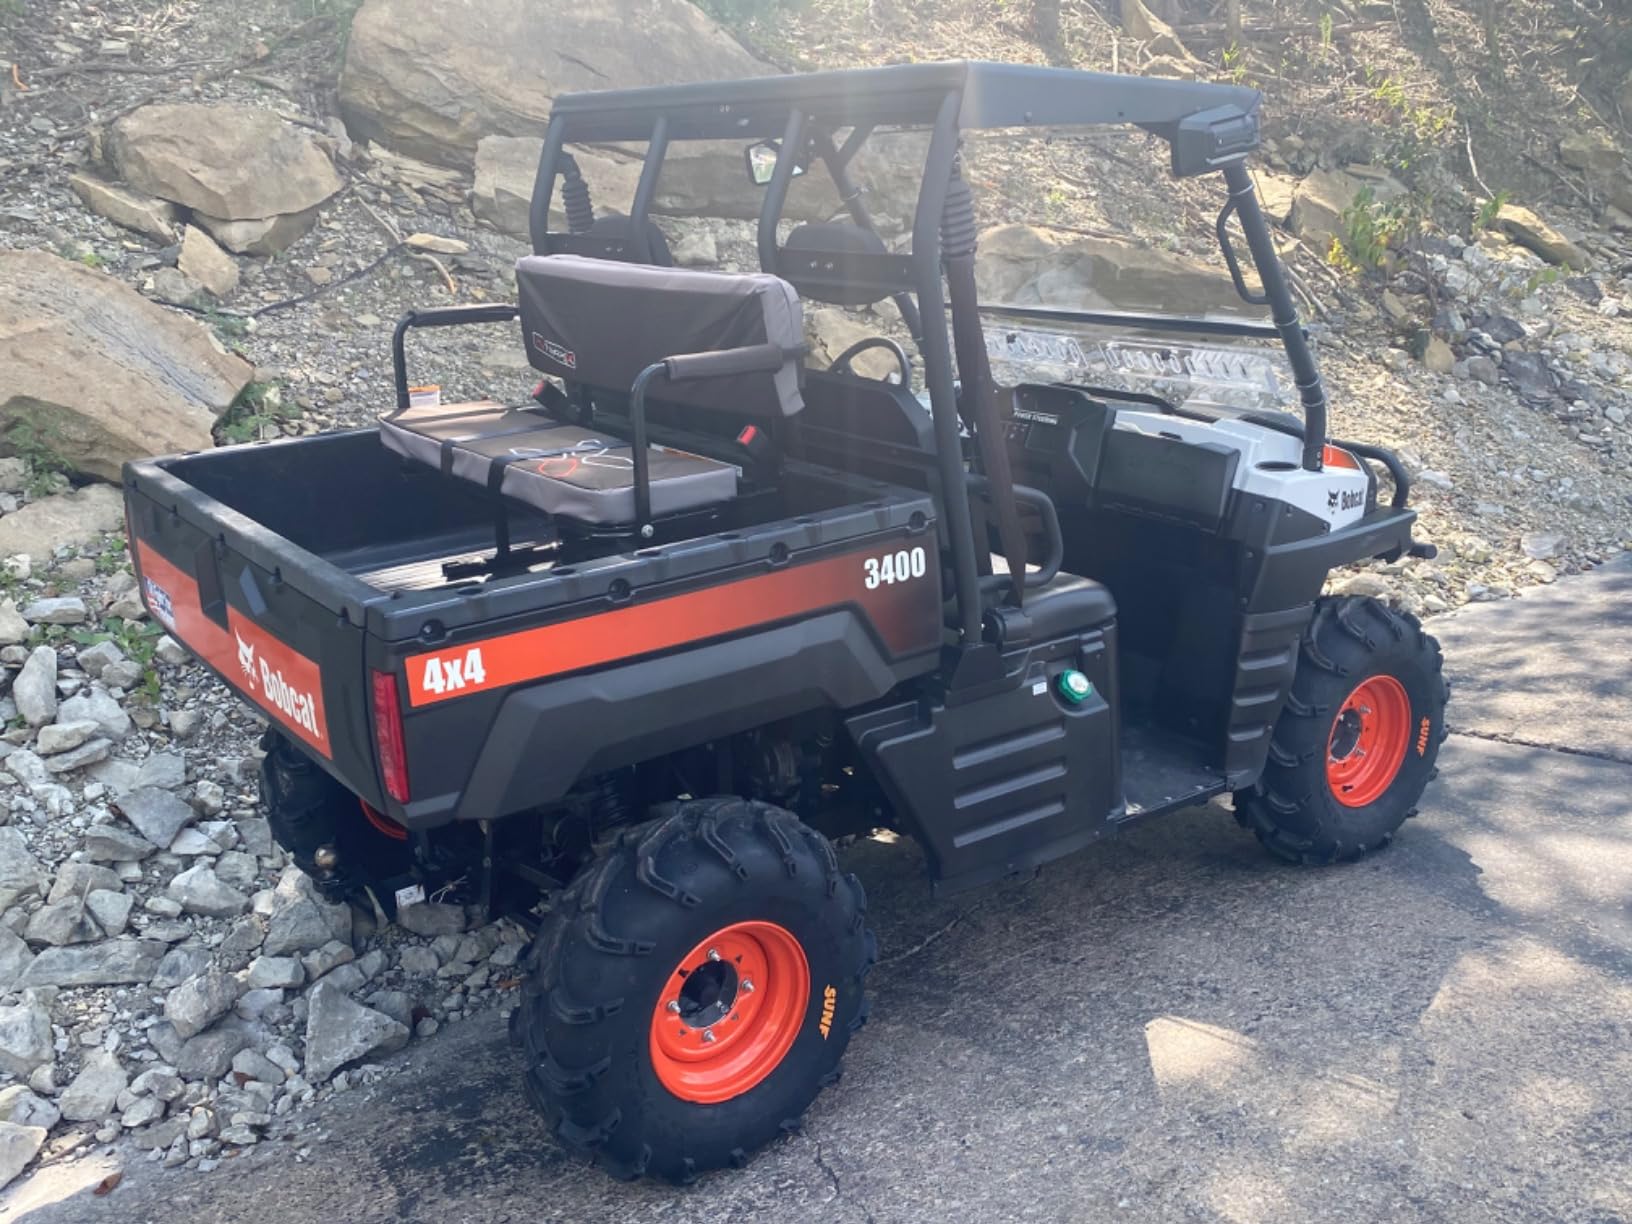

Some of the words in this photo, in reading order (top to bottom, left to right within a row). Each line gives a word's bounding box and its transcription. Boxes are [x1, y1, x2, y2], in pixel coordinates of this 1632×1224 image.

[1342, 490, 1363, 510] Bobcat
[864, 547, 926, 590] 3400
[423, 648, 486, 695] 4x4
[259, 656, 319, 738] Bobcat
[1417, 716, 1430, 757] SUNF
[819, 984, 836, 1040] SUNF
